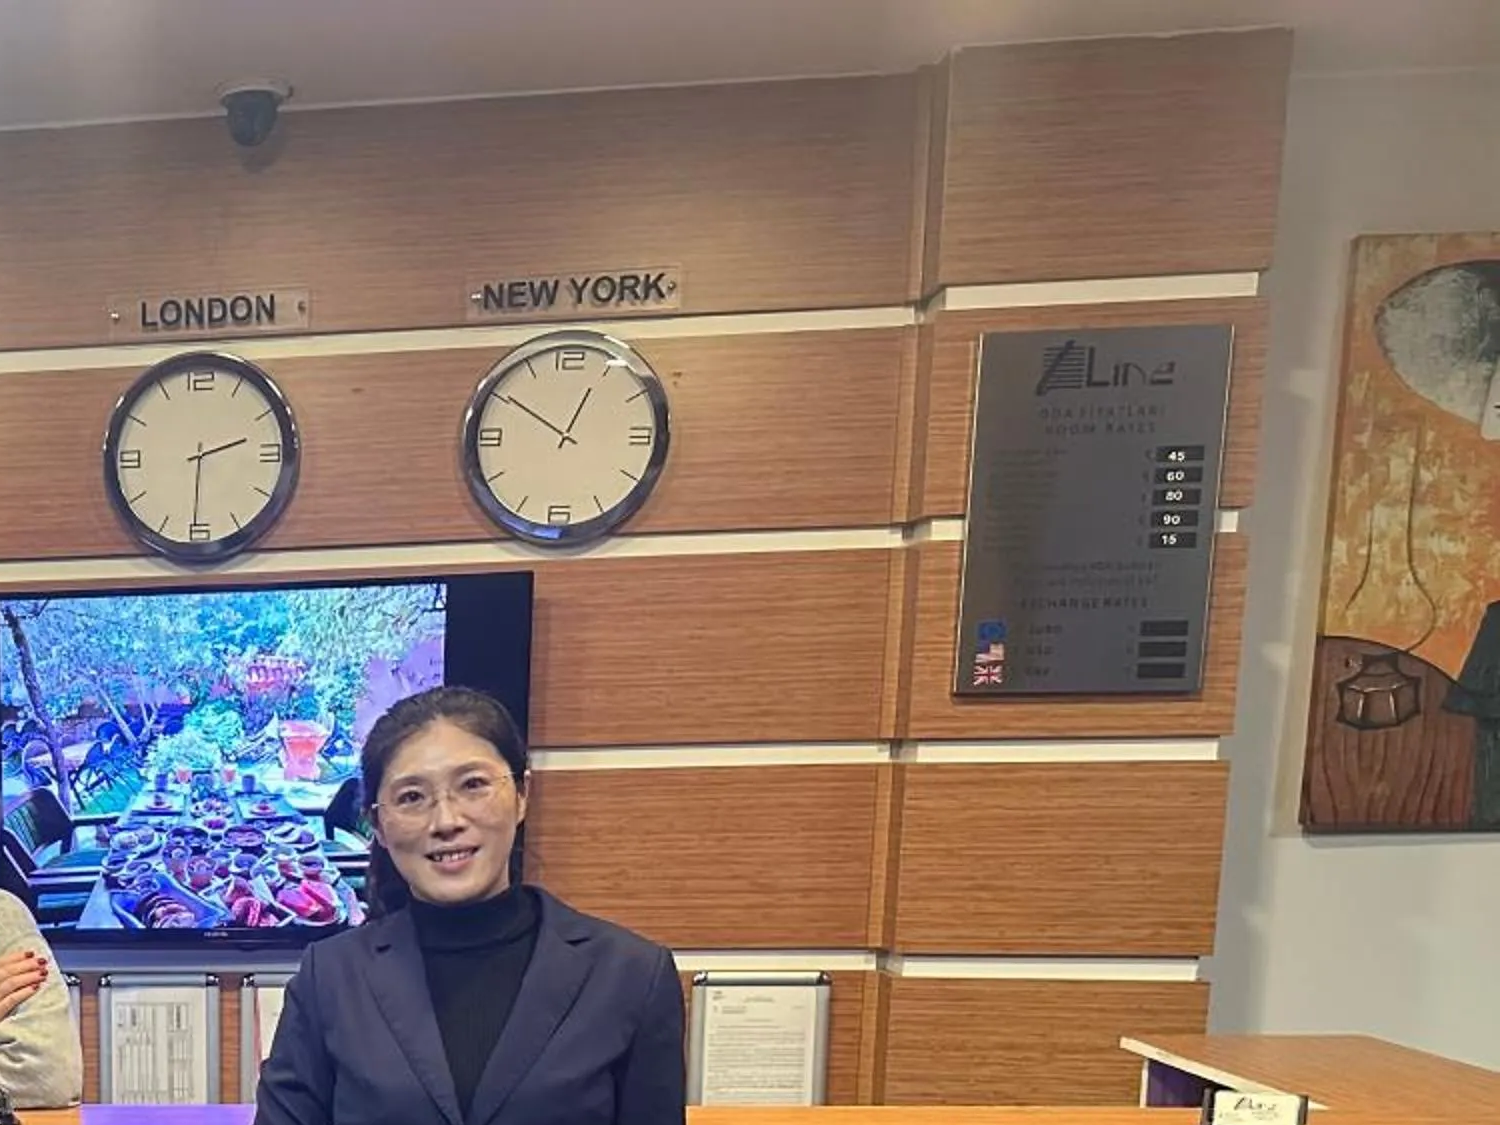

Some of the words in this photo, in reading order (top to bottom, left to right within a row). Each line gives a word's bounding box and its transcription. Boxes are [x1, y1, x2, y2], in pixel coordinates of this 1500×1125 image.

[483, 279, 559, 310] NEW
[569, 272, 667, 305] YORK
[140, 293, 276, 332] LONDON
[555, 351, 586, 371] 12
[187, 371, 215, 391] 12
[480, 427, 502, 447] 9
[629, 427, 652, 446] 3
[120, 449, 141, 469] 9
[259, 443, 281, 463] 3
[1167, 450, 1186, 462] 45
[1166, 470, 1185, 482] 60
[547, 505, 570, 524] 6
[1163, 514, 1181, 526] 90
[190, 524, 211, 541] 6
[1161, 534, 1177, 545] 15
